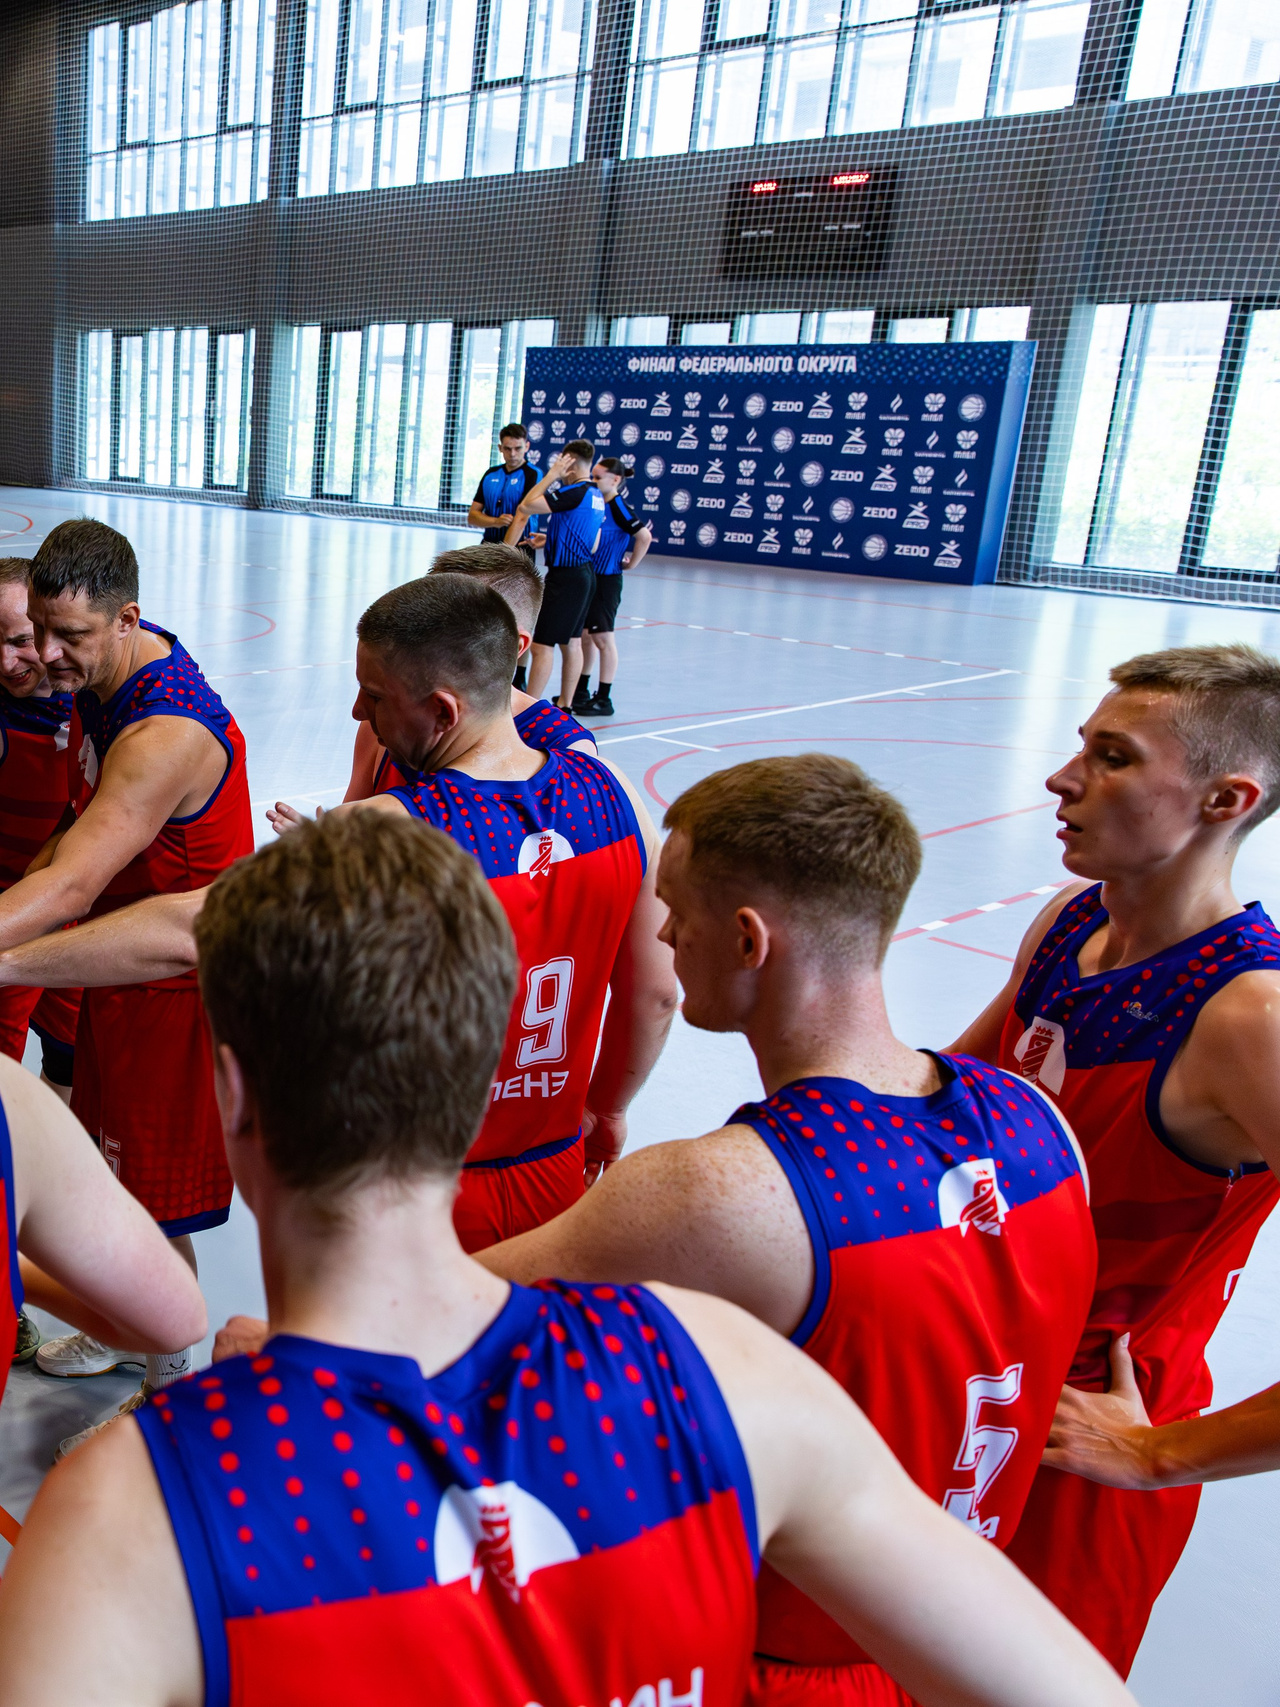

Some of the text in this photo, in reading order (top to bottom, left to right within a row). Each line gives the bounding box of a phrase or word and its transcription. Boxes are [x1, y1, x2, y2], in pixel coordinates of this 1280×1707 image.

[627, 355, 857, 375] ФИНАЛ ФЕДЕРАЛЬНОГО ОКРУГА
[620, 399, 647, 409] ZEDO
[772, 401, 803, 412] ZEDO
[645, 430, 672, 441] ZEDO
[801, 433, 833, 445] ZEDO
[671, 464, 699, 475] ZEDO
[830, 470, 863, 482] ZEDO
[697, 497, 725, 509] ZEDO
[862, 507, 897, 519] ZEDO
[723, 532, 753, 544] ZEDO
[894, 544, 929, 557] ZEDO
[515, 955, 575, 1069] 9
[942, 1362, 1024, 1533] 5
